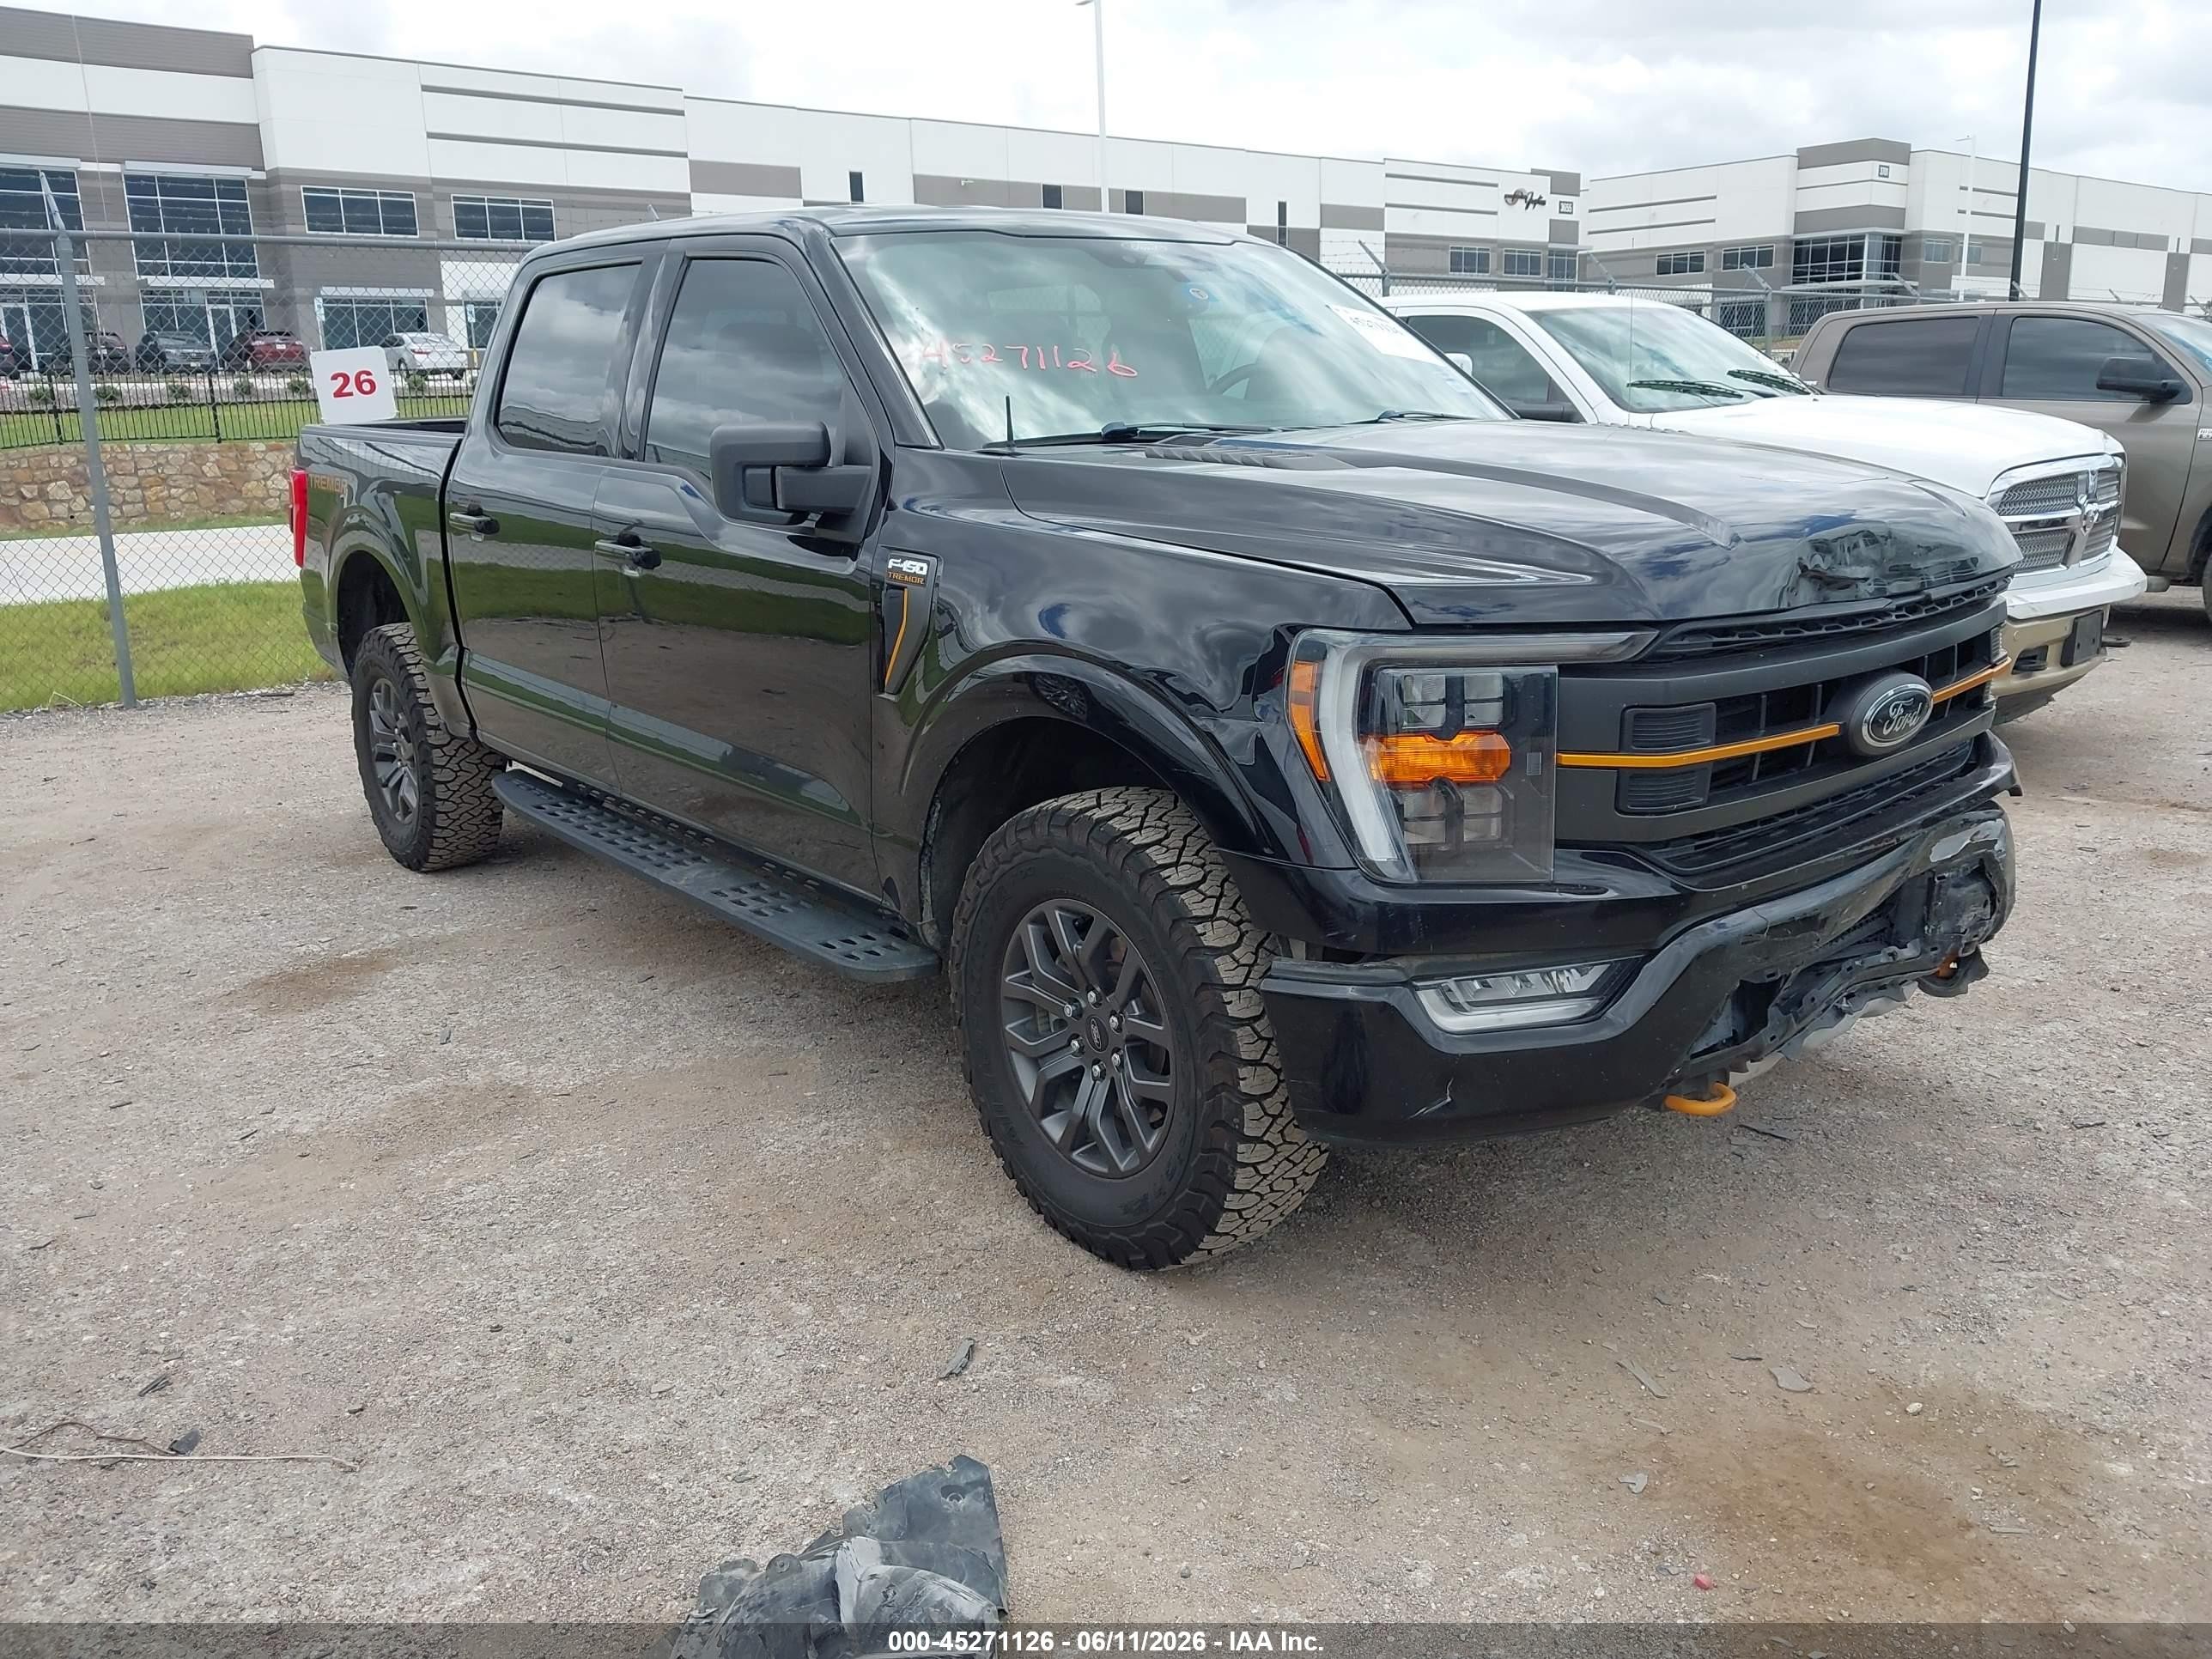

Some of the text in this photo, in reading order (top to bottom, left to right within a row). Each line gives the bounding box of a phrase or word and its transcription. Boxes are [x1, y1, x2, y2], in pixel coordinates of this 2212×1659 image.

[922, 340, 1138, 377] 45271126
[331, 370, 376, 398] 26
[888, 558, 927, 575] F-150
[888, 571, 926, 584] TREMOR
[1882, 697, 1923, 735] Ford
